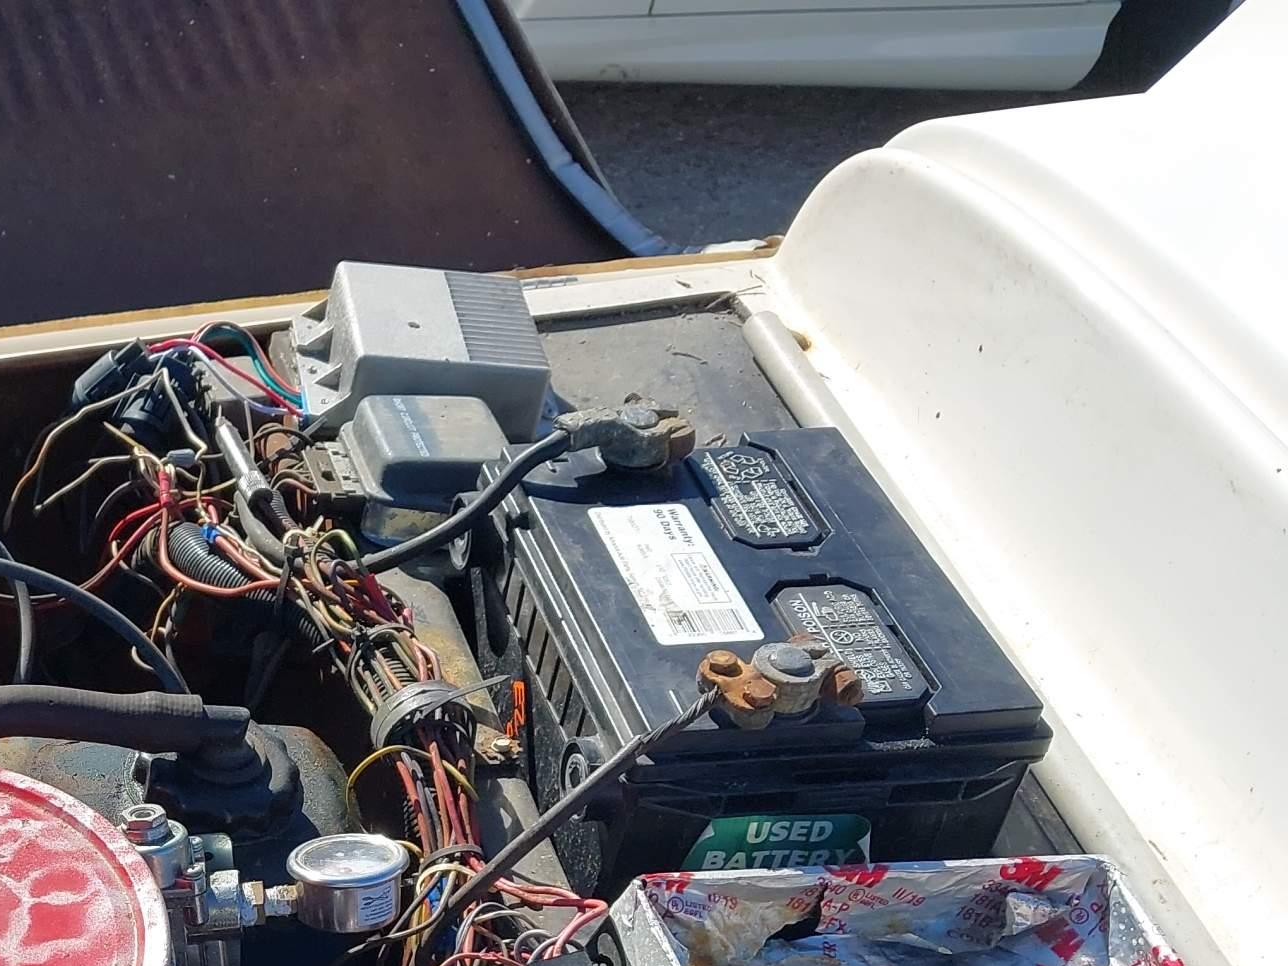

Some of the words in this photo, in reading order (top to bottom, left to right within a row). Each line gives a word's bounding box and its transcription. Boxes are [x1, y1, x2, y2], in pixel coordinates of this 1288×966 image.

[651, 509, 666, 518] 90
[657, 520, 679, 540] Days
[663, 508, 697, 546] Warranty:
[787, 598, 821, 633] POISON
[746, 821, 833, 844] USED
[702, 849, 859, 870] BATTERY
[892, 887, 926, 907] 11/19
